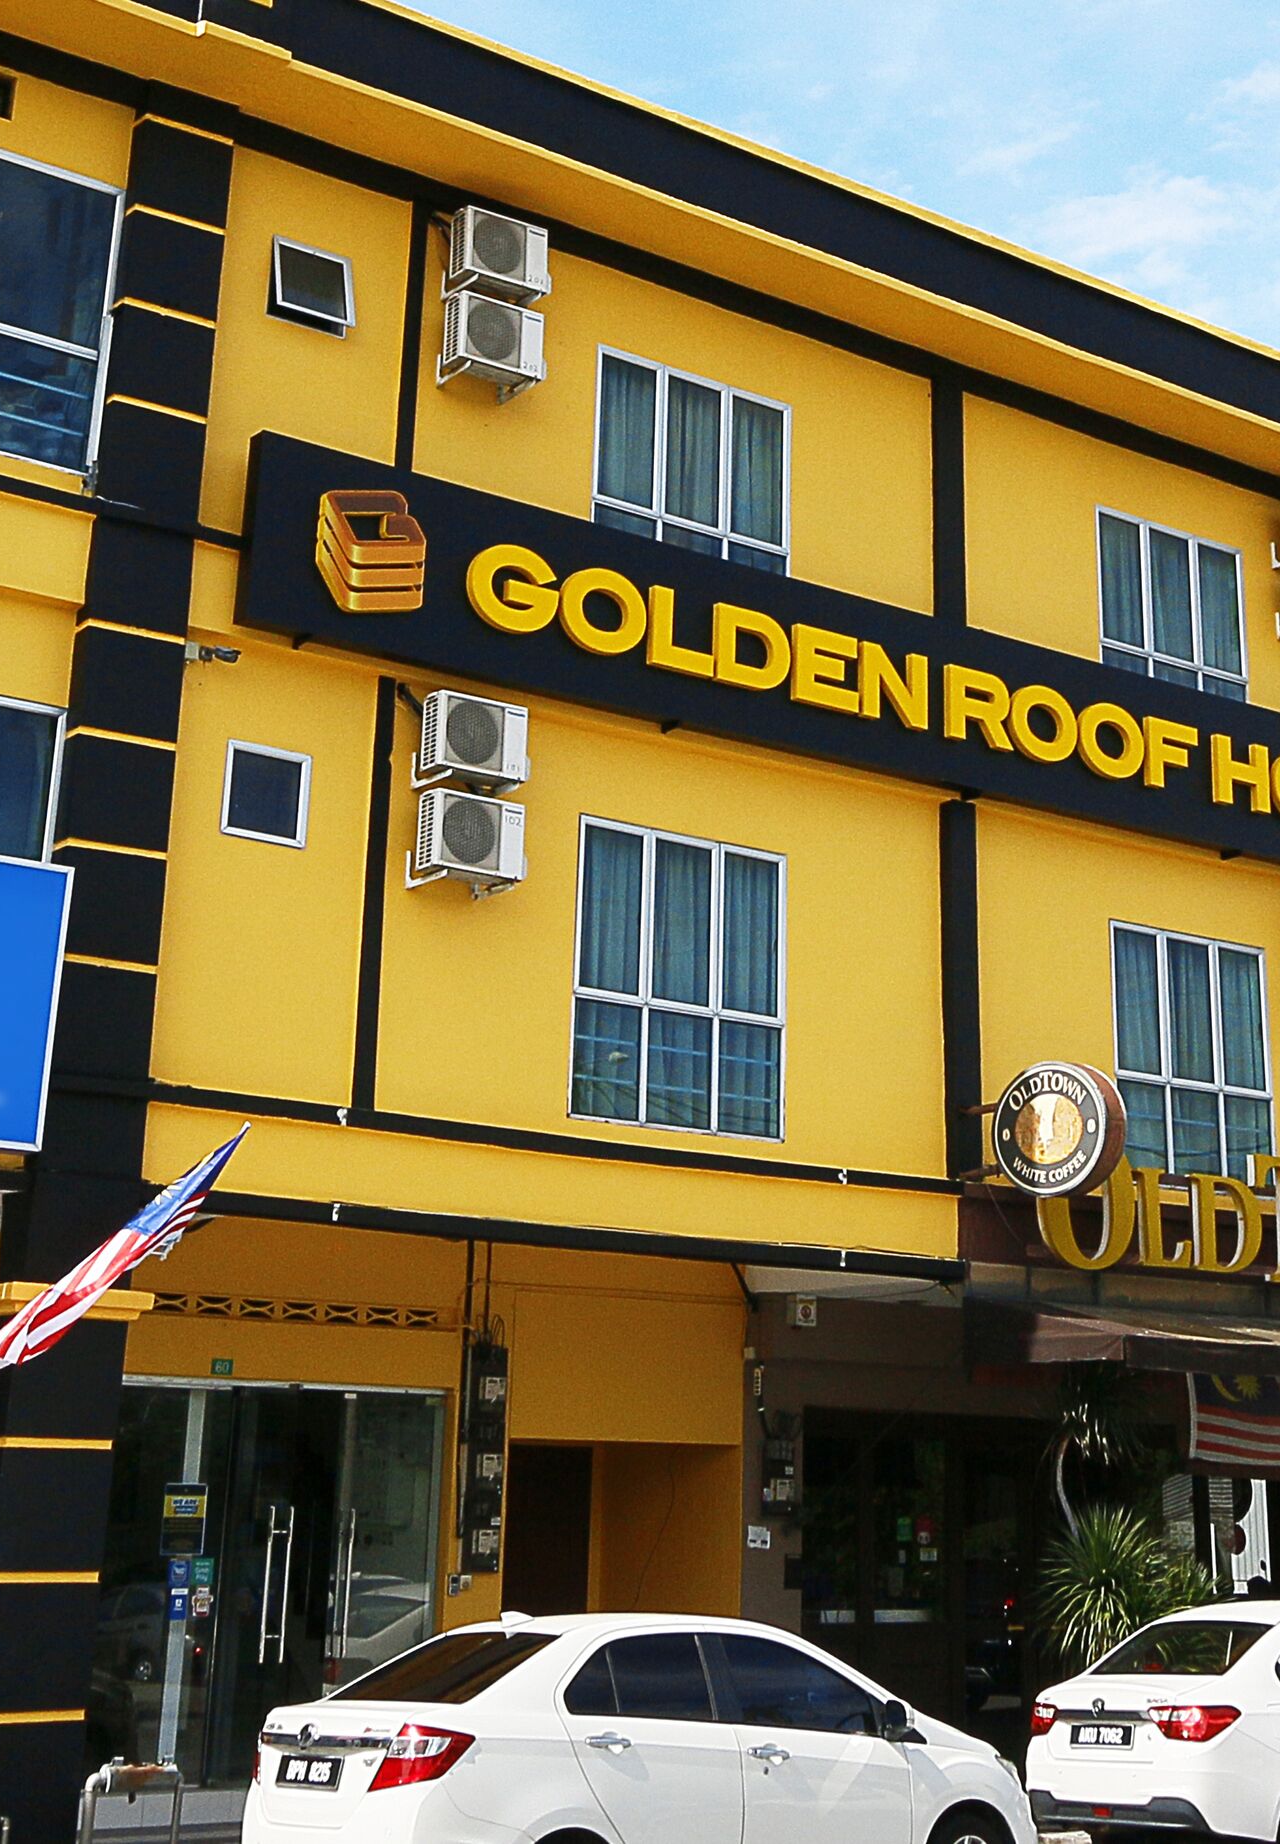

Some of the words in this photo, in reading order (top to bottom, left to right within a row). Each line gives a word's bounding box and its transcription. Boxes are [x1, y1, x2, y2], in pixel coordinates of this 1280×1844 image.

[466, 543, 929, 732] GOLDEN
[943, 663, 1199, 790] ROOF
[504, 815, 522, 827] 102
[1013, 1157, 1047, 1183] WHITE
[1048, 1150, 1087, 1183] COFFEE
[215, 1360, 230, 1373] 60
[1078, 1727, 1098, 1744] AKU
